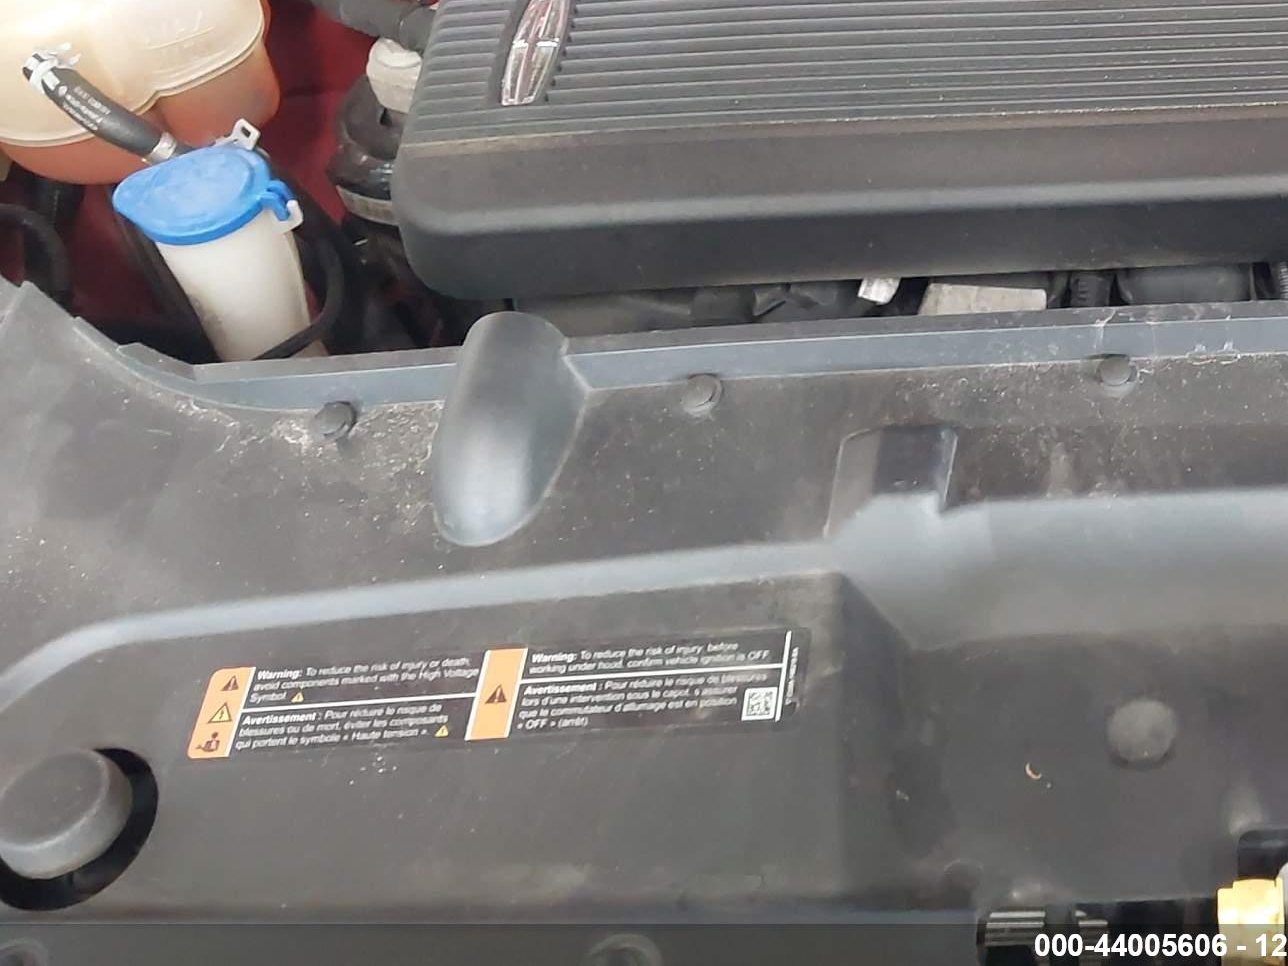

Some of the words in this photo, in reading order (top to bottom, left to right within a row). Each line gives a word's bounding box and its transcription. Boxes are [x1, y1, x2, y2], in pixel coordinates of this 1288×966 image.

[529, 664, 566, 675] working
[568, 661, 596, 670] under
[626, 656, 663, 667] confirm
[665, 655, 698, 665] vehicle
[700, 653, 735, 664] ignition
[736, 652, 745, 660] is
[531, 651, 577, 664] Warning:
[580, 650, 591, 659] To
[592, 648, 625, 659] reduce
[627, 647, 644, 656] the
[645, 646, 661, 655] risk
[664, 645, 675, 654] of
[707, 641, 738, 651] before
[253, 681, 279, 691] avoid
[280, 677, 339, 691] components
[340, 675, 377, 685] marked
[379, 673, 398, 682] with
[400, 672, 416, 680] the
[418, 670, 441, 681] High
[442, 667, 479, 680] Voltage
[256, 667, 302, 681] Warning:
[305, 667, 317, 676] To
[318, 665, 351, 675] reduce
[353, 664, 368, 673] the
[370, 663, 387, 671] risk
[390, 661, 400, 670] of
[401, 660, 427, 672] injury
[524, 682, 596, 695] Avertissement
[604, 679, 627, 689] Pour
[629, 678, 663, 688] réduire
[664, 677, 673, 686] le
[675, 676, 704, 686] risque
[706, 675, 720, 683] de
[721, 671, 767, 683] blessures
[519, 710, 537, 719] que
[550, 704, 612, 716] commutateur
[667, 700, 683, 708] est
[699, 696, 737, 707] position
[521, 697, 539, 706] lors
[570, 691, 625, 703] intervention
[626, 691, 649, 700] sous
[651, 690, 660, 698] le
[239, 724, 285, 737] blessures
[286, 725, 300, 733] ou
[302, 723, 315, 732] de
[343, 718, 371, 730] éviter
[372, 717, 387, 727] les
[389, 713, 449, 728] composants
[242, 710, 316, 726] Avertissement
[324, 708, 347, 719] Pour
[349, 706, 384, 718] réduire
[385, 705, 395, 715] le
[396, 704, 427, 715] risque
[428, 703, 442, 711] de
[525, 719, 547, 729] OFF
[234, 739, 250, 749] qui
[252, 736, 287, 748] portent
[288, 735, 298, 744] le
[299, 732, 340, 745] symbole
[351, 729, 381, 741] Haute
[382, 726, 419, 738] tension
